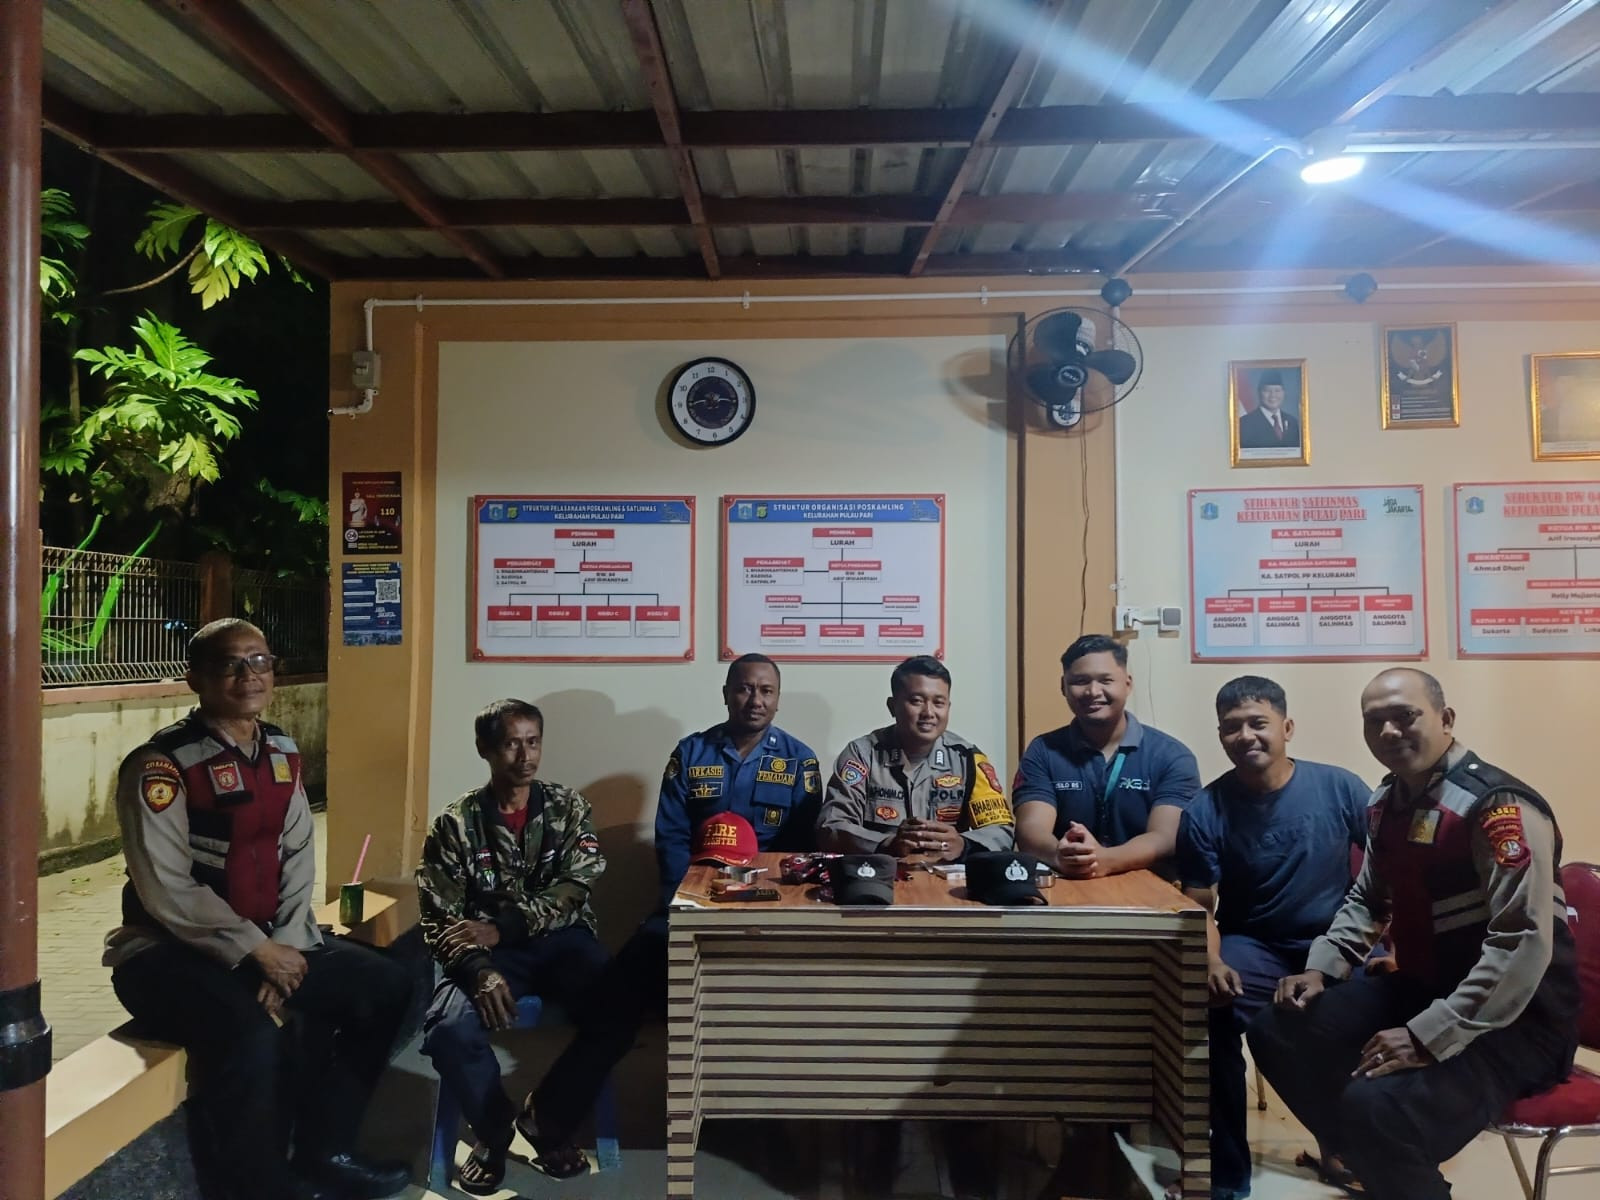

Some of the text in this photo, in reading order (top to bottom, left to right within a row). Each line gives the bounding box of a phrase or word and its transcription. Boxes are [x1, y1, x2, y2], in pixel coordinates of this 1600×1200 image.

[1244, 497, 1300, 509] STRUKTUR
[380, 507, 395, 516] 110
[1237, 509, 1367, 522] KELURAHAN PULAU PARI
[930, 789, 965, 801] POLR
[705, 823, 737, 838] FIRE
